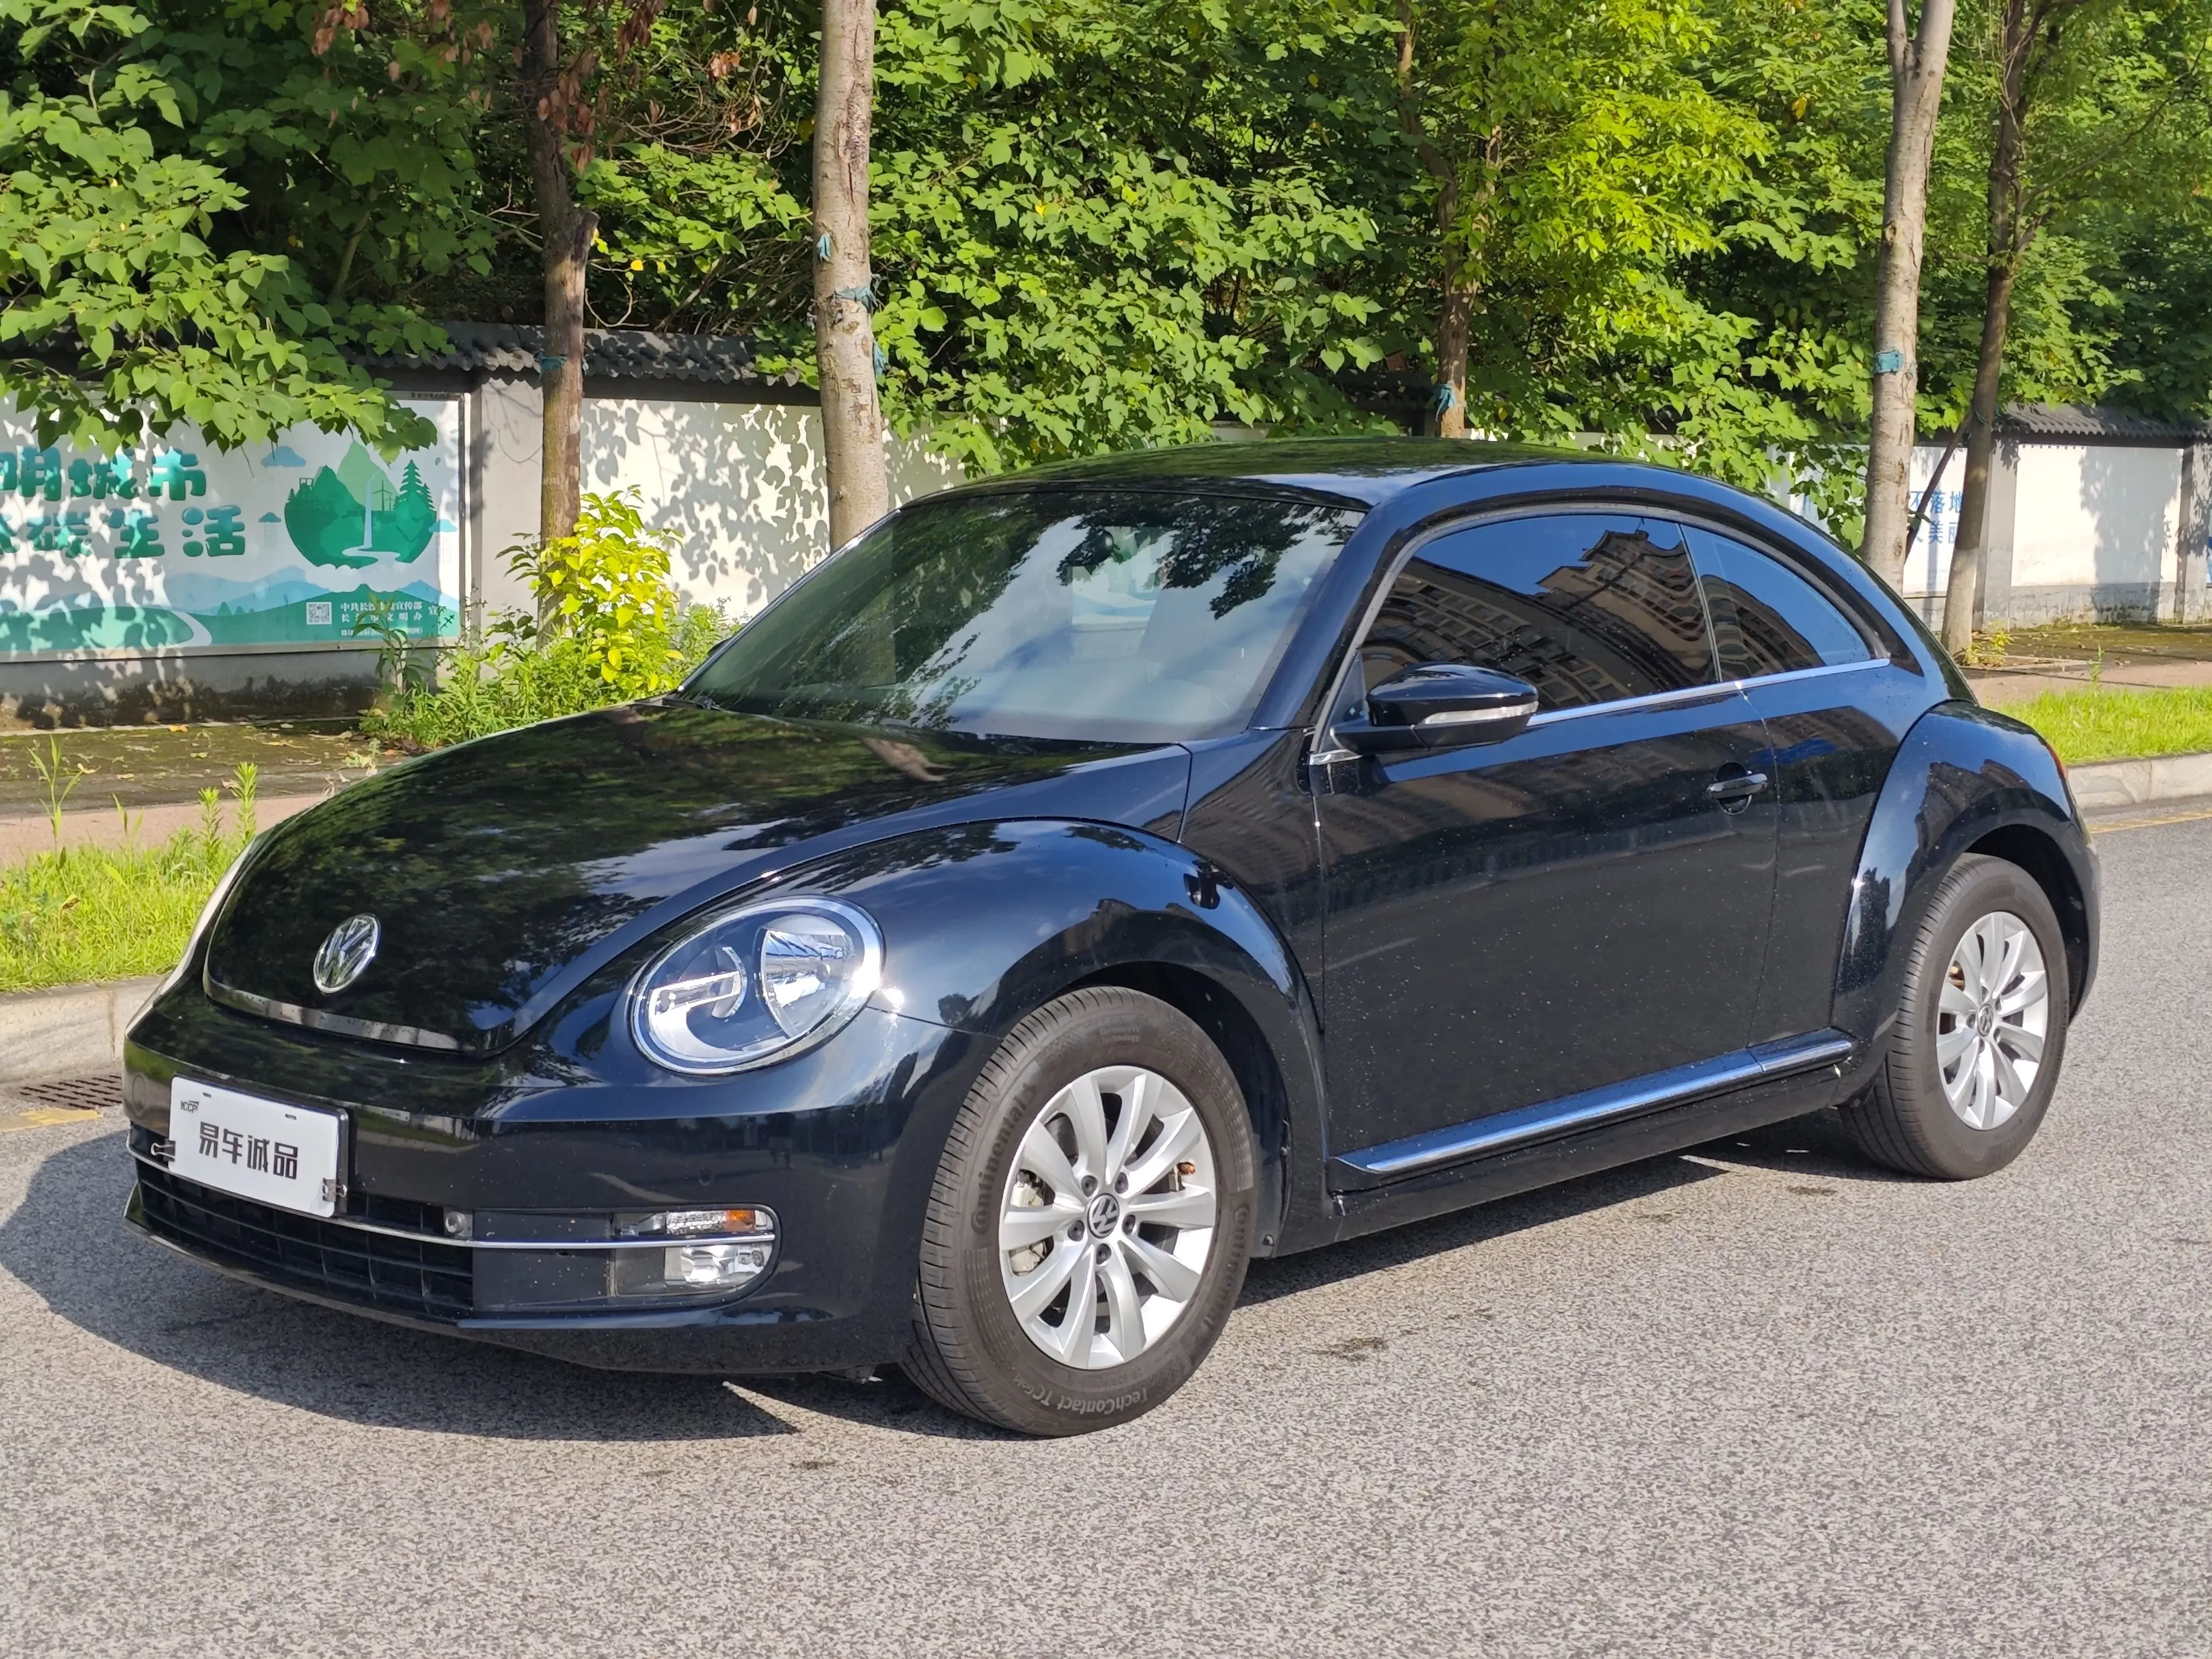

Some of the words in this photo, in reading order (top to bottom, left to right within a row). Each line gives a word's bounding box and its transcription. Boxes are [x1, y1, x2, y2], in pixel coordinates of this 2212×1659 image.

[199, 1121, 299, 1180] 易车诚品
[1032, 1384, 1053, 1407] TC
[1057, 1387, 1148, 1415] TechContact
